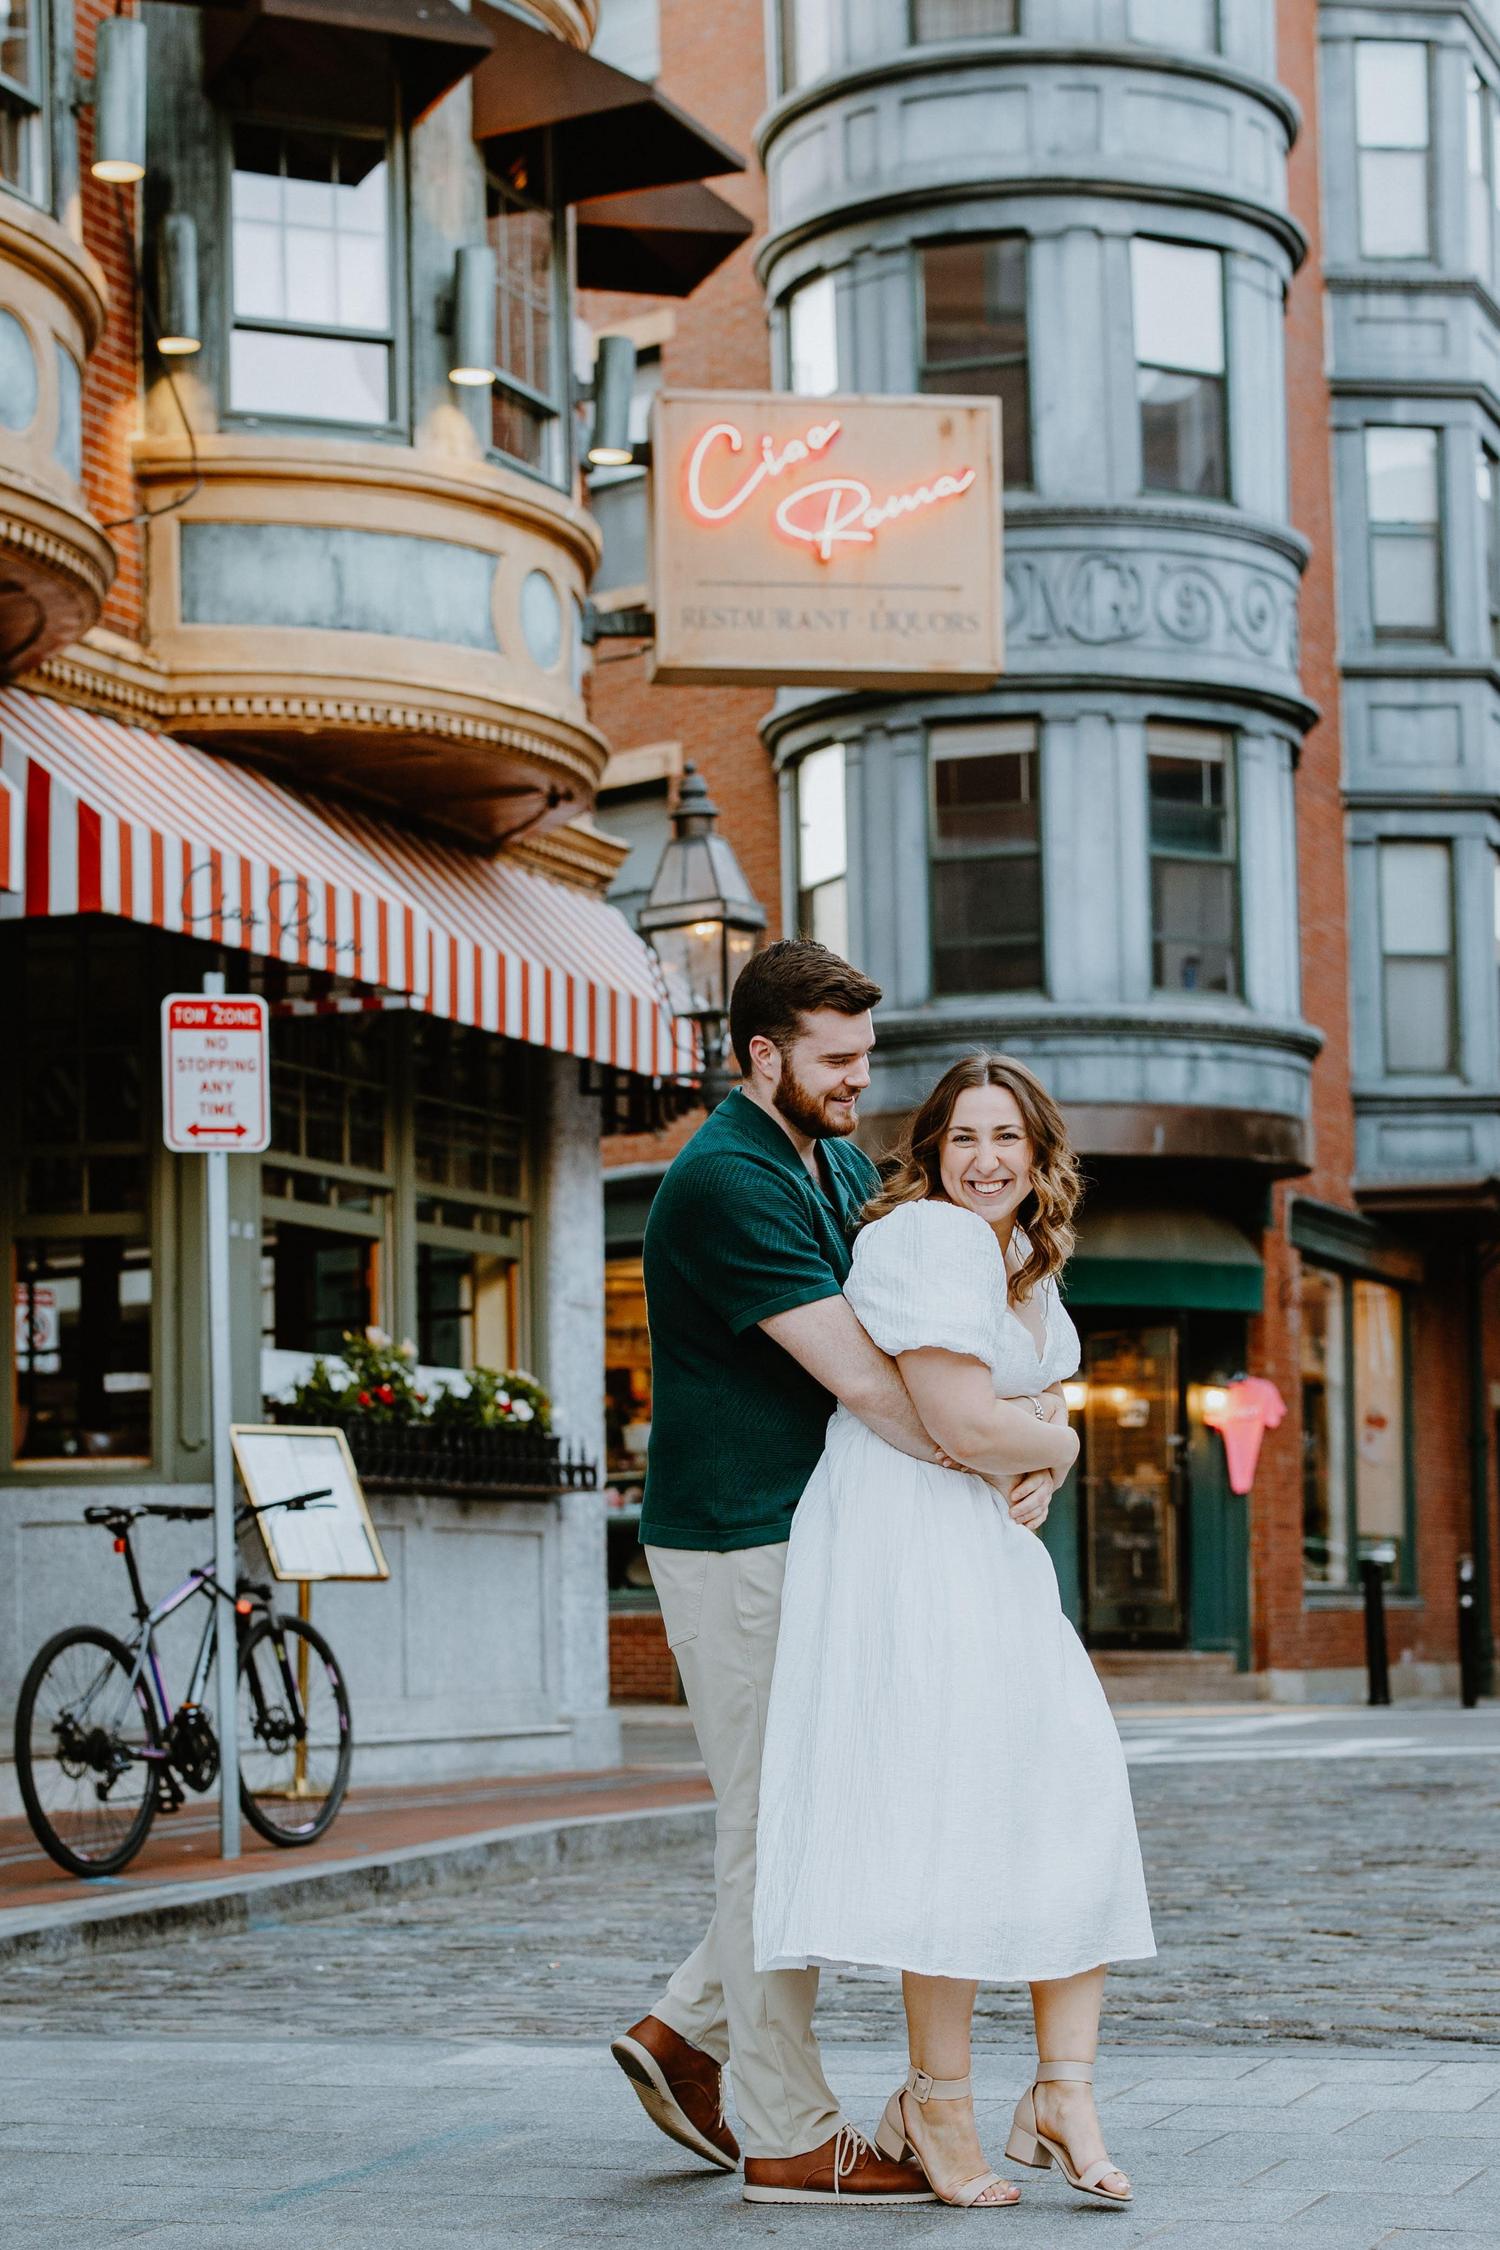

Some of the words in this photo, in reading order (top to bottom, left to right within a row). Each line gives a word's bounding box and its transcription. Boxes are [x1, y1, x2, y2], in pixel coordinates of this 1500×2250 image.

[687, 420, 841, 520] Ciao
[776, 468, 977, 560] Roma
[681, 607, 849, 631] RESTAURANT
[870, 608, 981, 637] LIQUORS
[174, 1007, 207, 1024] TOW
[213, 1007, 257, 1025] ZONE
[205, 1036, 228, 1050] NO
[178, 1057, 256, 1073] STOPPING
[201, 1080, 234, 1095] ANY
[200, 1102, 234, 1117] TIME
